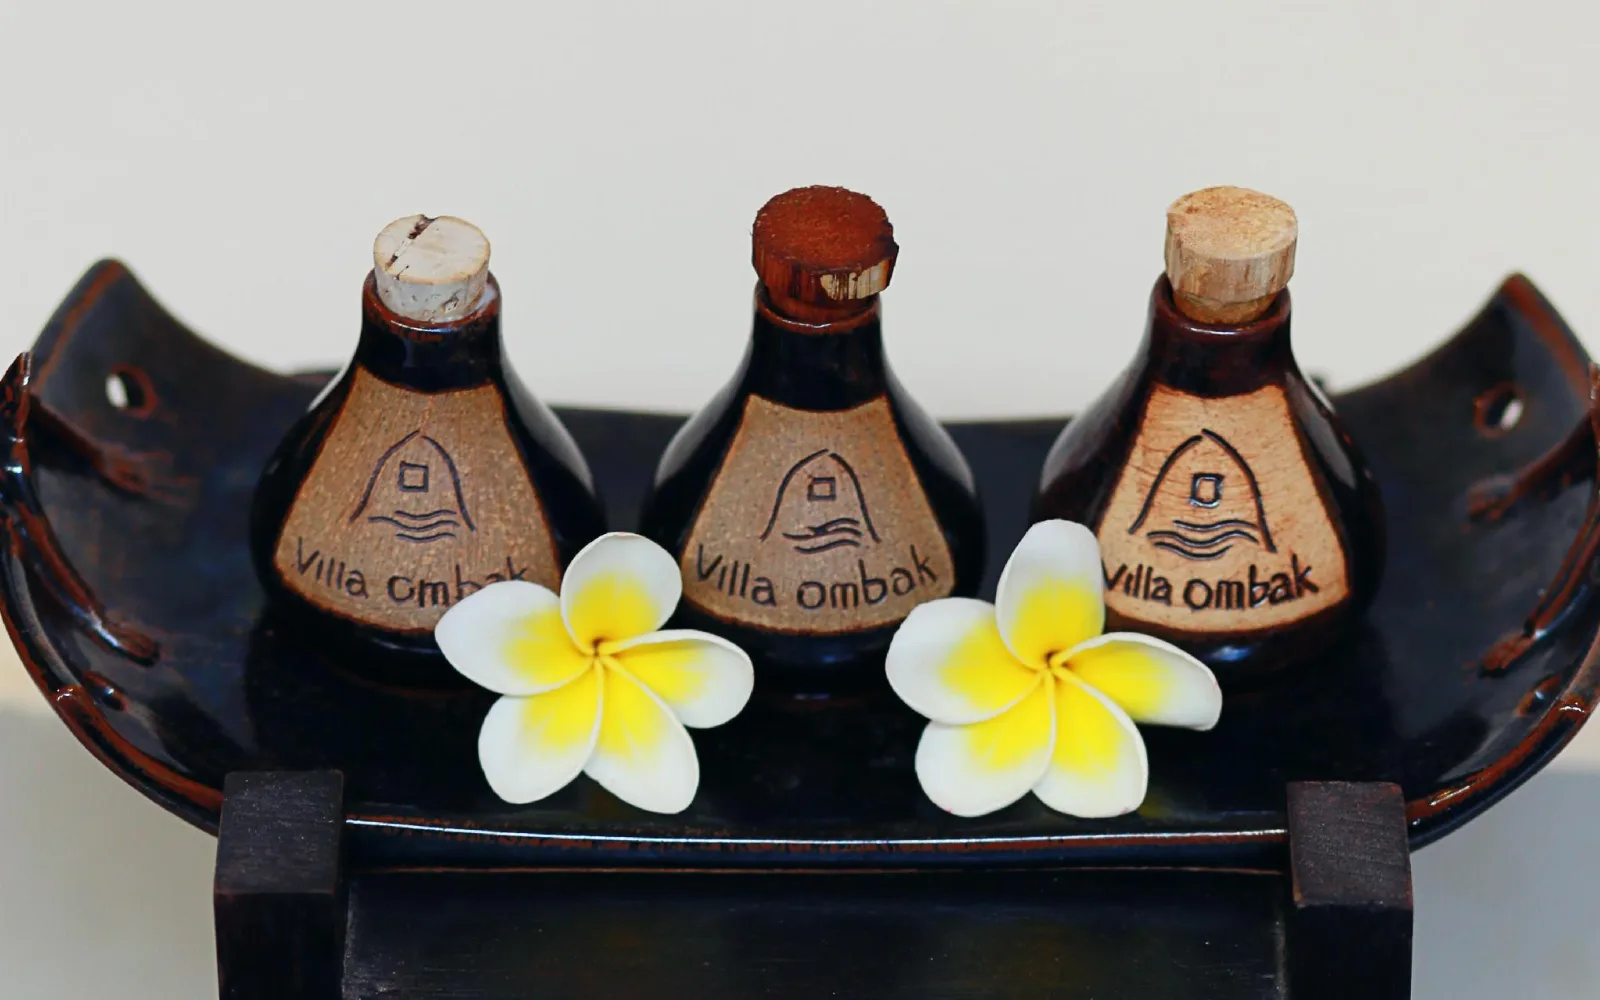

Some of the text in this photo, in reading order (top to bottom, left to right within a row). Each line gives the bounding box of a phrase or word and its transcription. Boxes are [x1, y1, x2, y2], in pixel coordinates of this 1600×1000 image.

[297, 536, 368, 599] Villa
[697, 543, 777, 607] Villa
[1101, 558, 1173, 606] Villa
